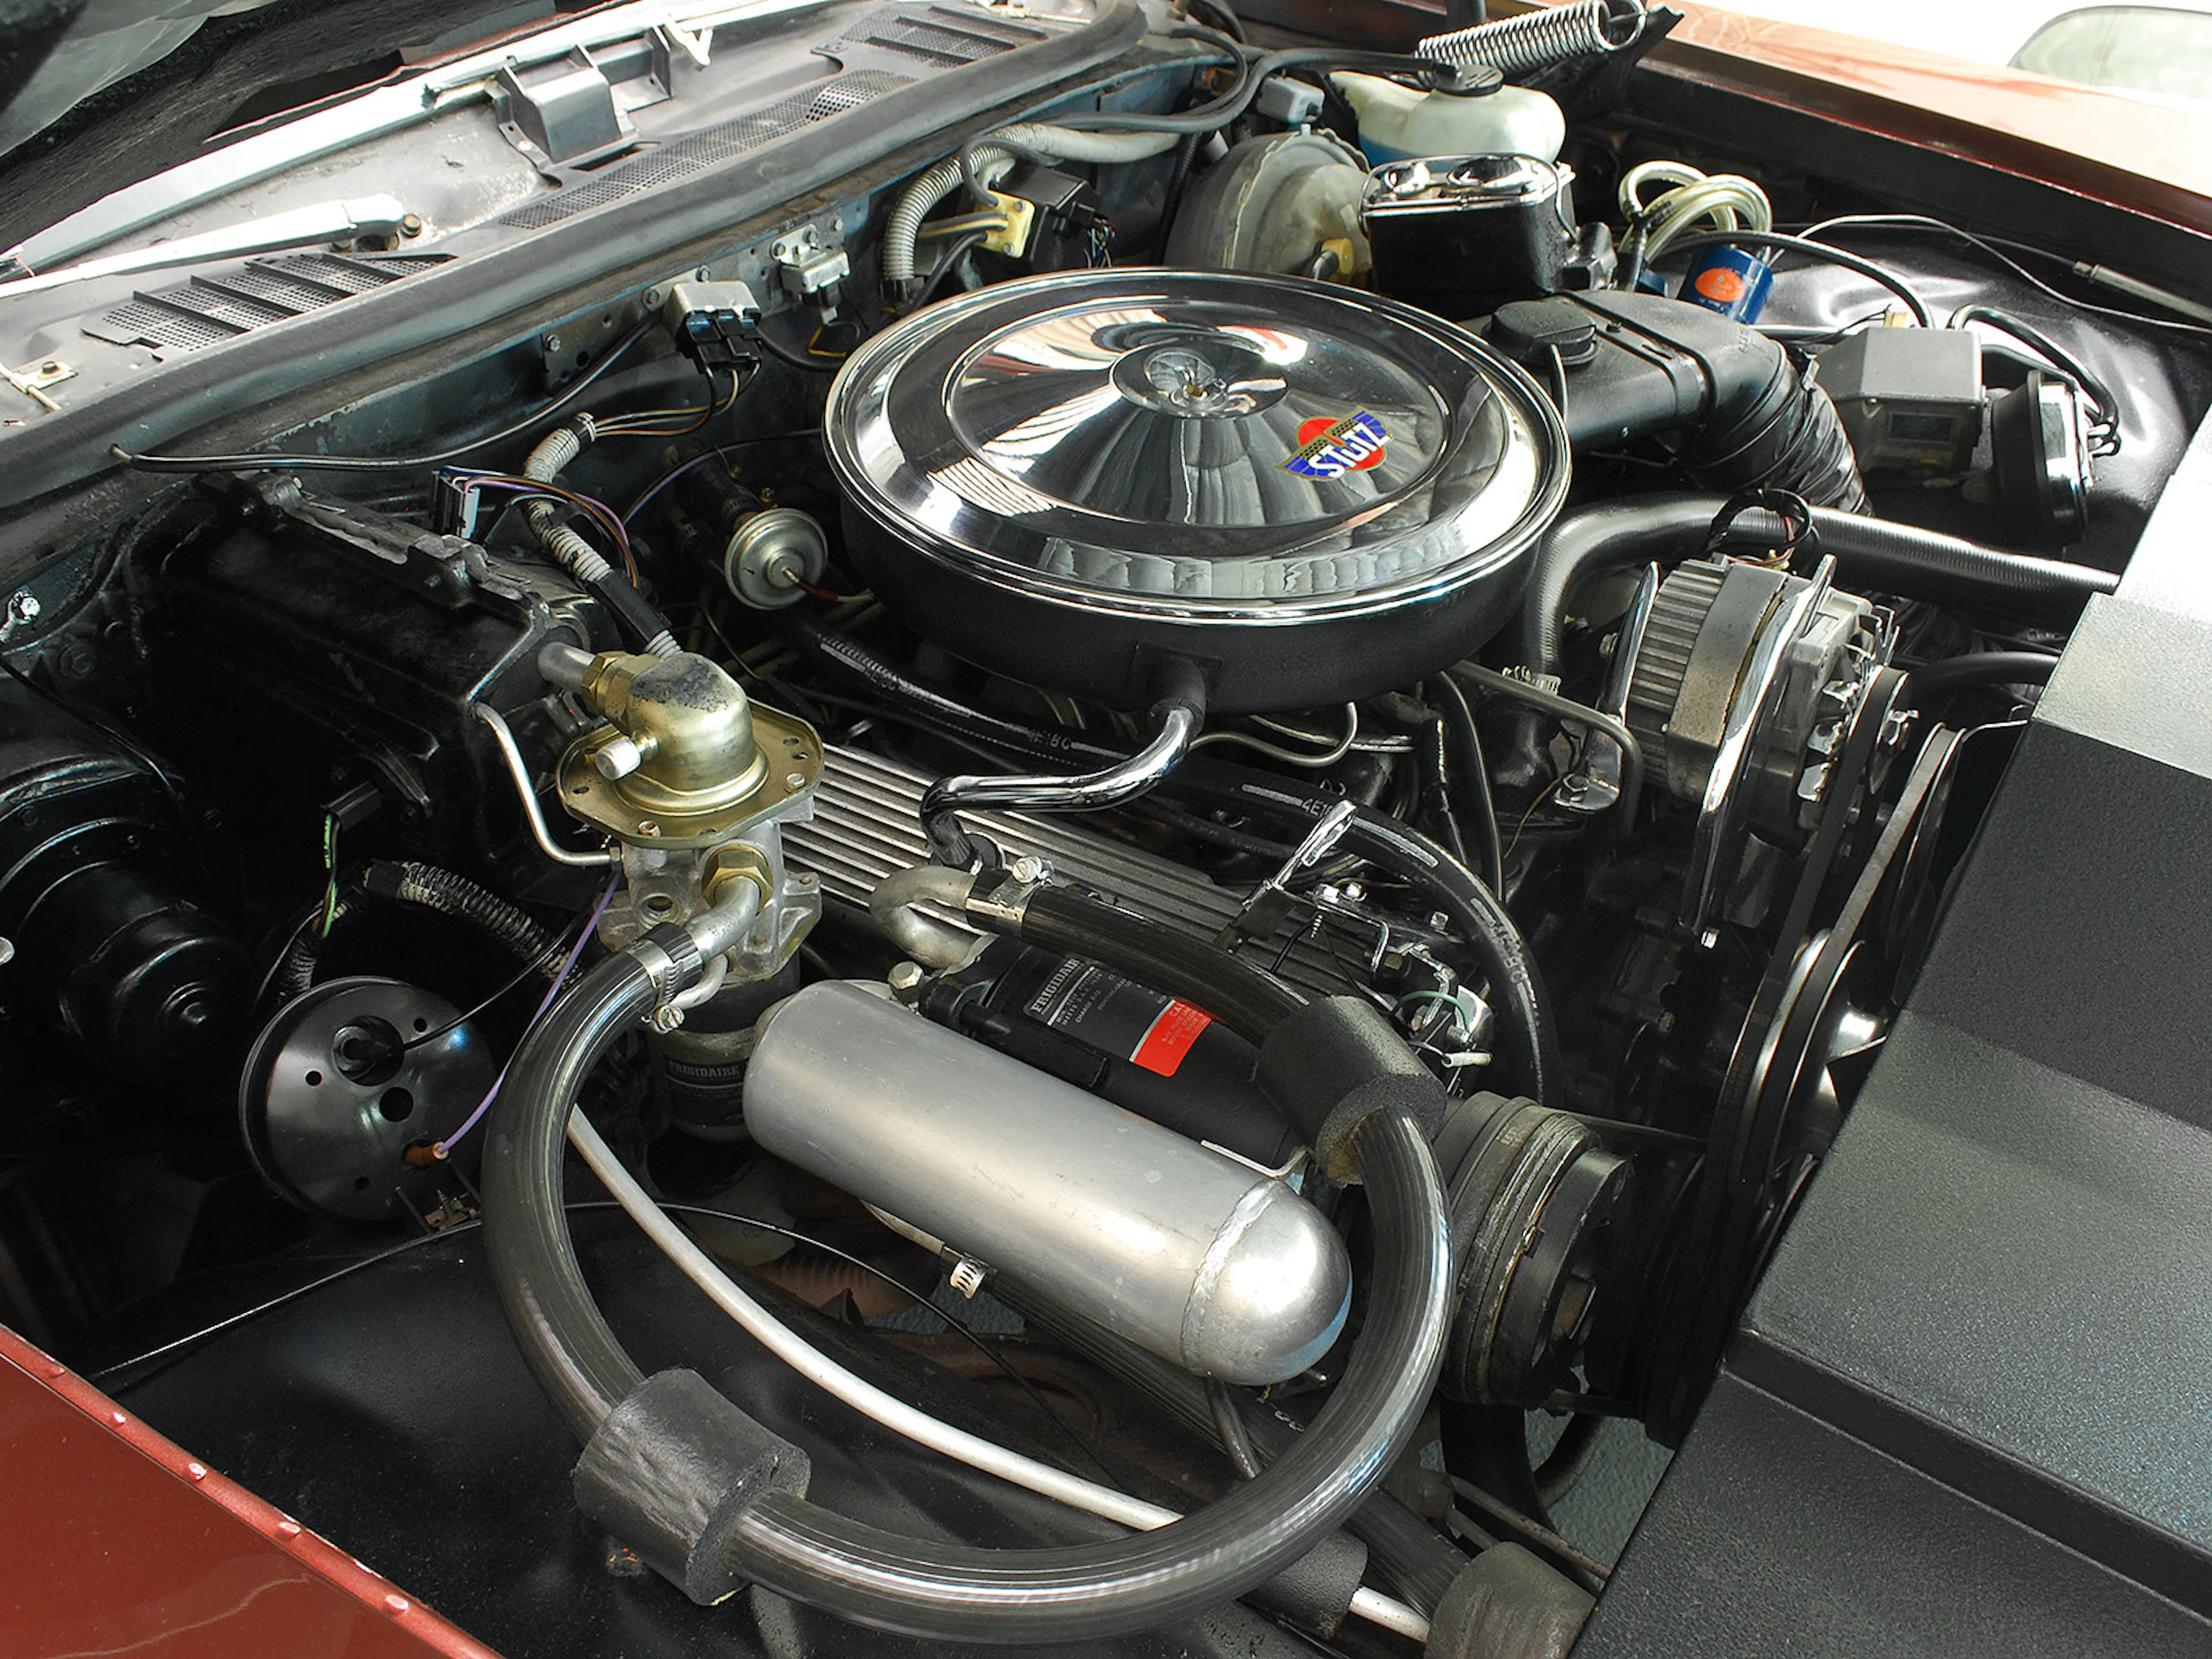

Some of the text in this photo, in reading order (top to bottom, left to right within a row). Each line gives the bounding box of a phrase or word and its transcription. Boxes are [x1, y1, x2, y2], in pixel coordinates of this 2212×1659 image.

[1308, 422, 1393, 478] STUTZ
[1031, 959, 1081, 1013] FRIGIDAIR
[669, 1060, 740, 1077] FRIGIDAIRE
